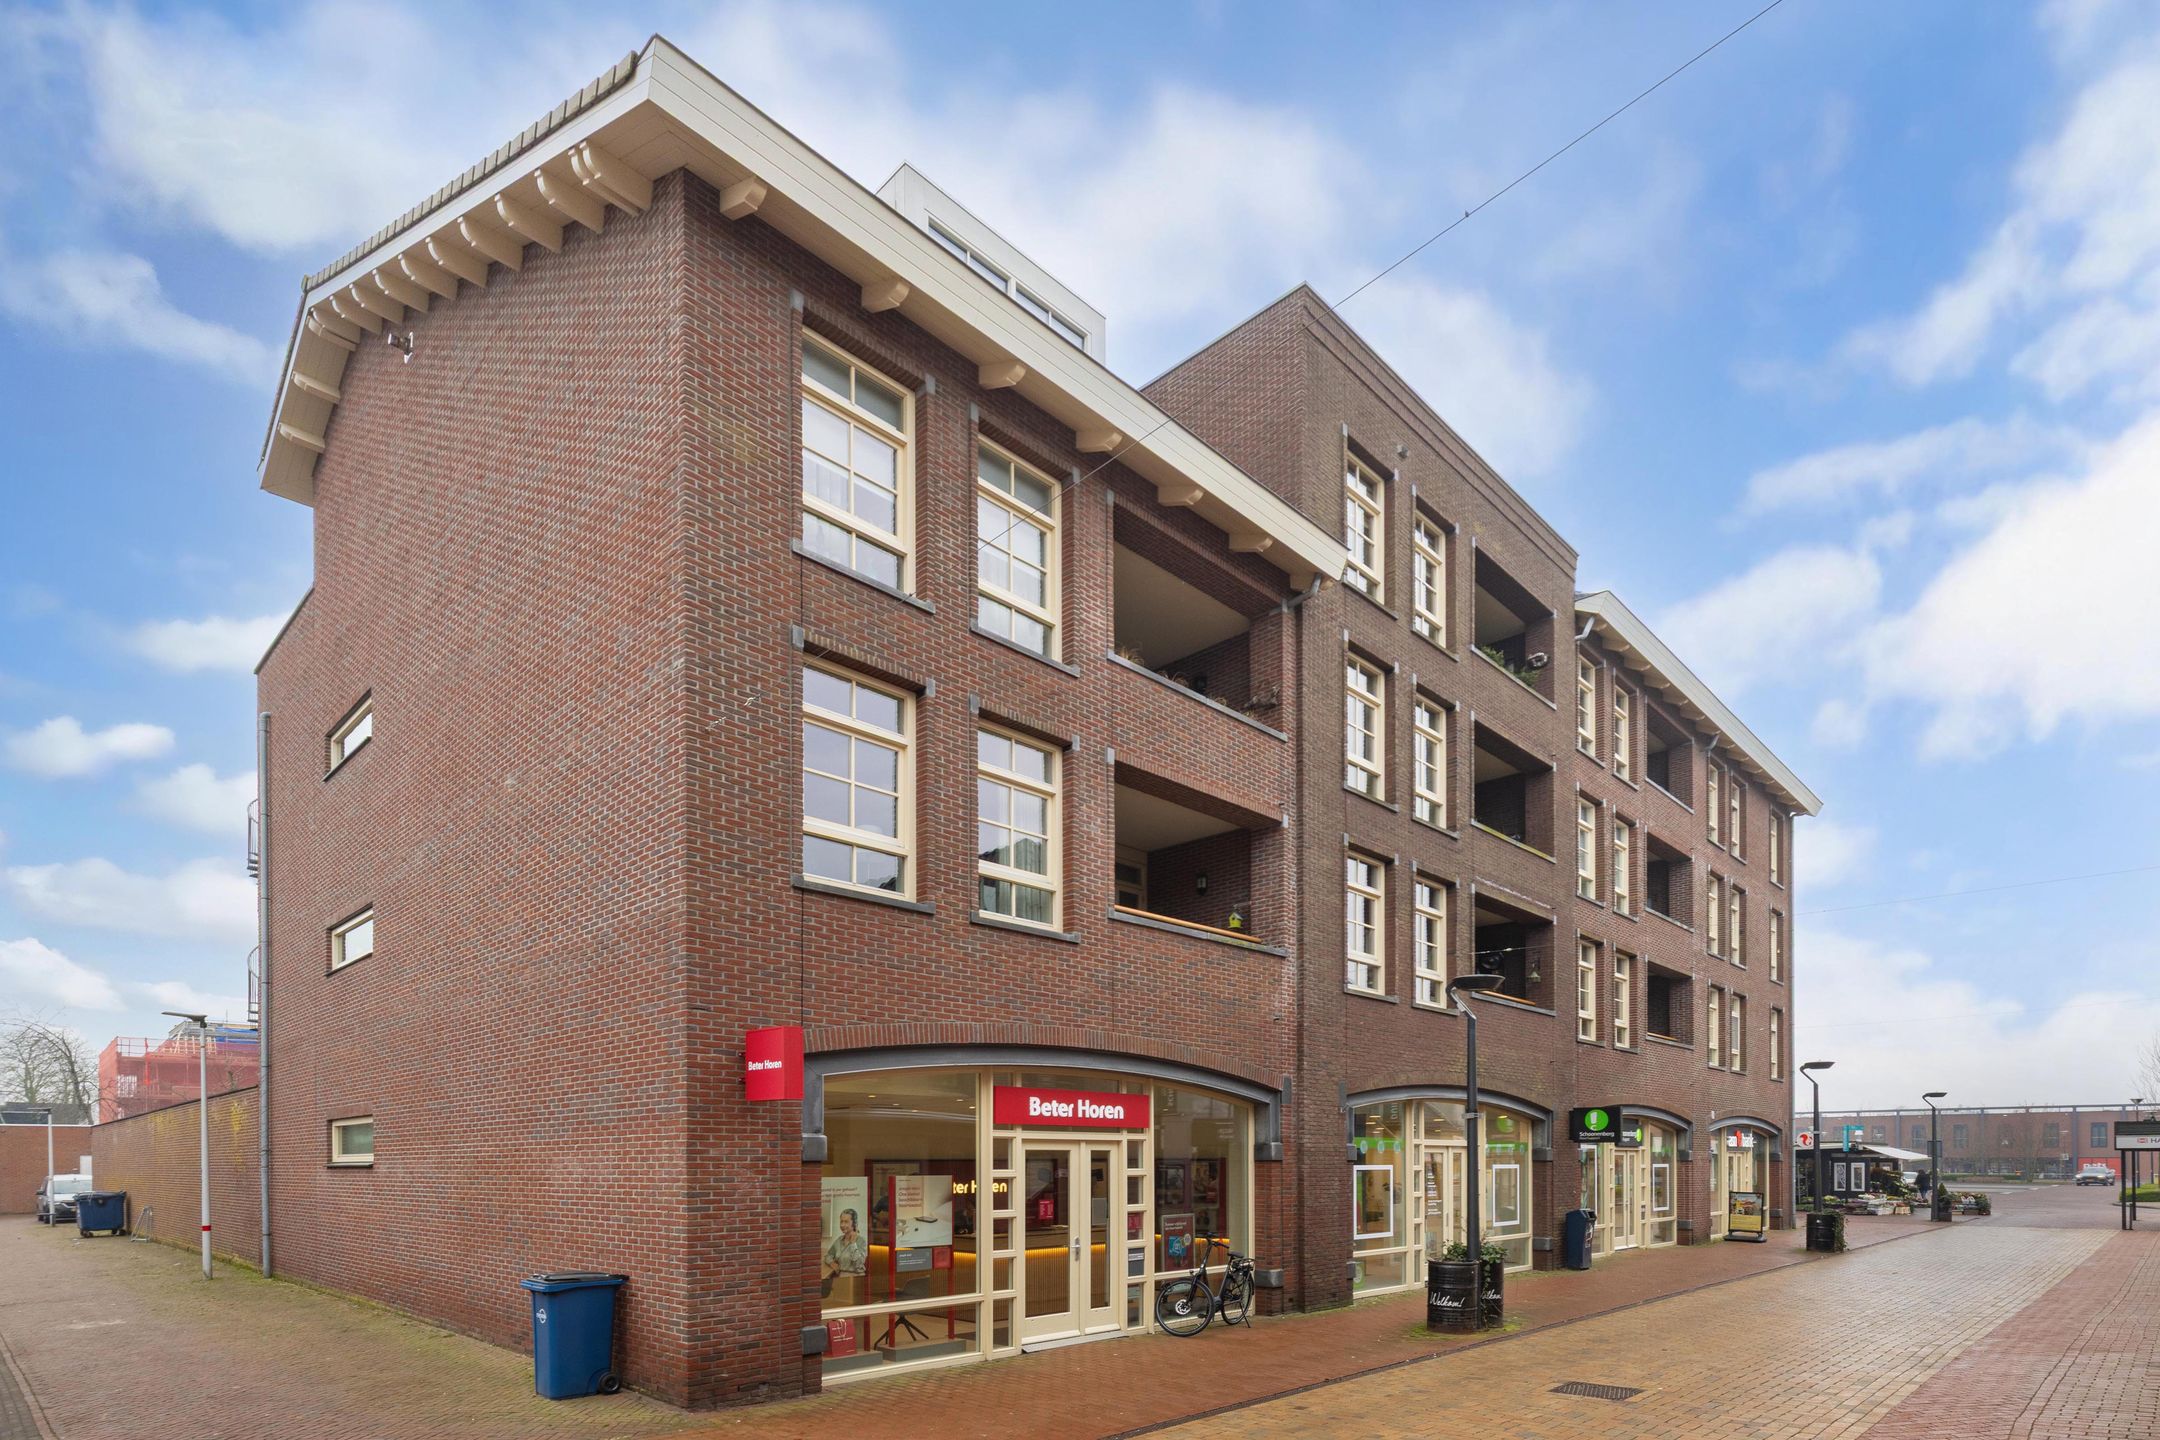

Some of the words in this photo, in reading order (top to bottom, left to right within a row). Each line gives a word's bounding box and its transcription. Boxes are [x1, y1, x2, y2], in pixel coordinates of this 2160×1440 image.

[748, 1061, 764, 1071] Beter
[764, 1059, 782, 1070] Horen
[1029, 1096, 1074, 1117] Beter
[1077, 1099, 1124, 1119] Horen
[1430, 1291, 1466, 1308] Welkom!
